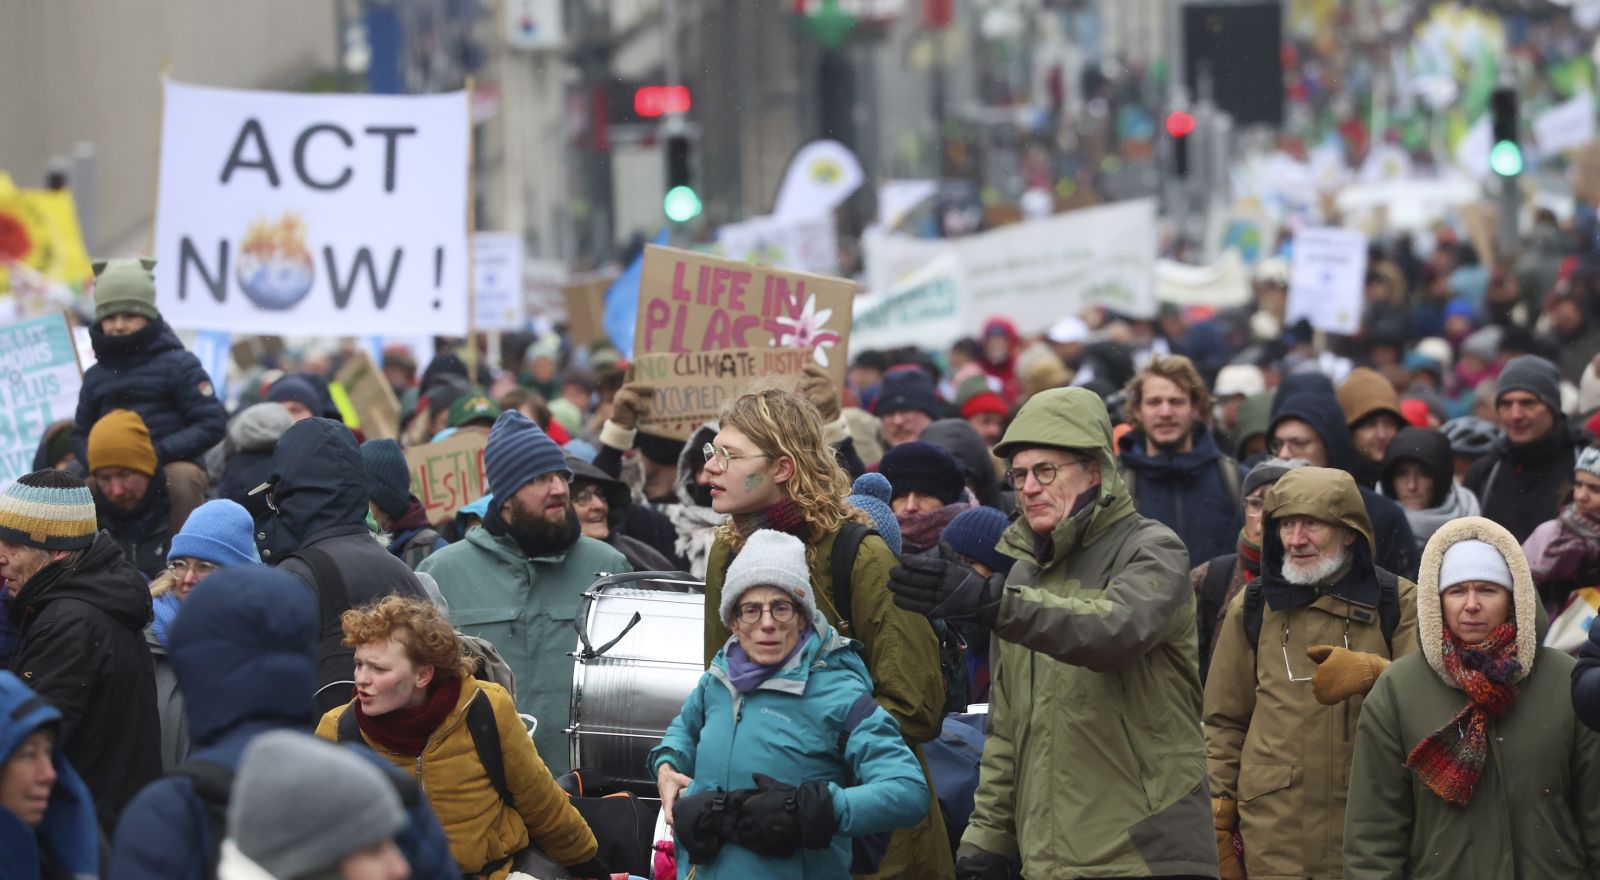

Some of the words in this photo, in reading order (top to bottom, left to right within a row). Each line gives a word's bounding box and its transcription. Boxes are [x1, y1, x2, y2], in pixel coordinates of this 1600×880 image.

[218, 117, 418, 194] ACT
[671, 261, 752, 312] LIFE
[761, 275, 806, 321] IN
[638, 355, 669, 380] NO
[673, 353, 756, 378] CLIMATE
[653, 384, 727, 416] OCCUPIED
